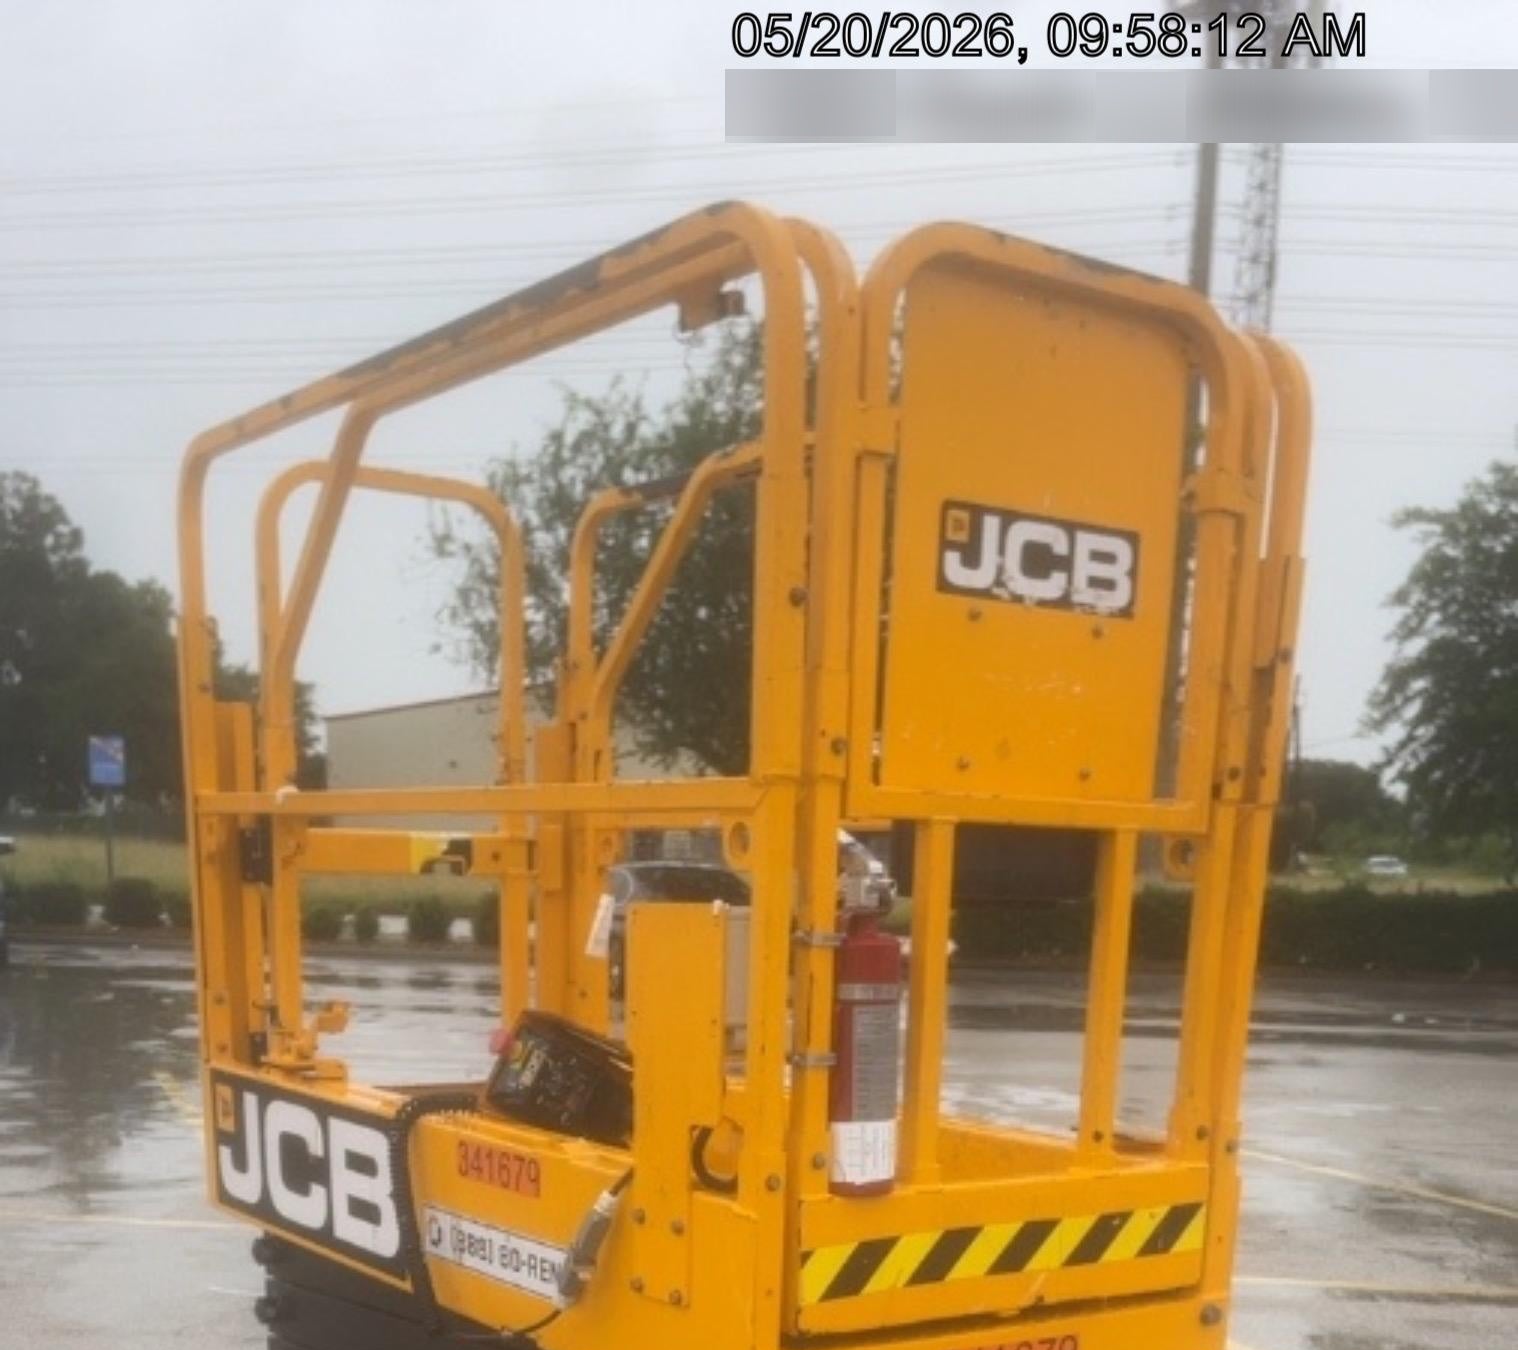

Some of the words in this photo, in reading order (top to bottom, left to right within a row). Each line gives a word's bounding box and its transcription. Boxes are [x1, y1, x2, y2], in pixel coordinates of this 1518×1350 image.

[944, 514, 1133, 614] JCB
[219, 1091, 400, 1259] JCB
[458, 1140, 541, 1199] 341679
